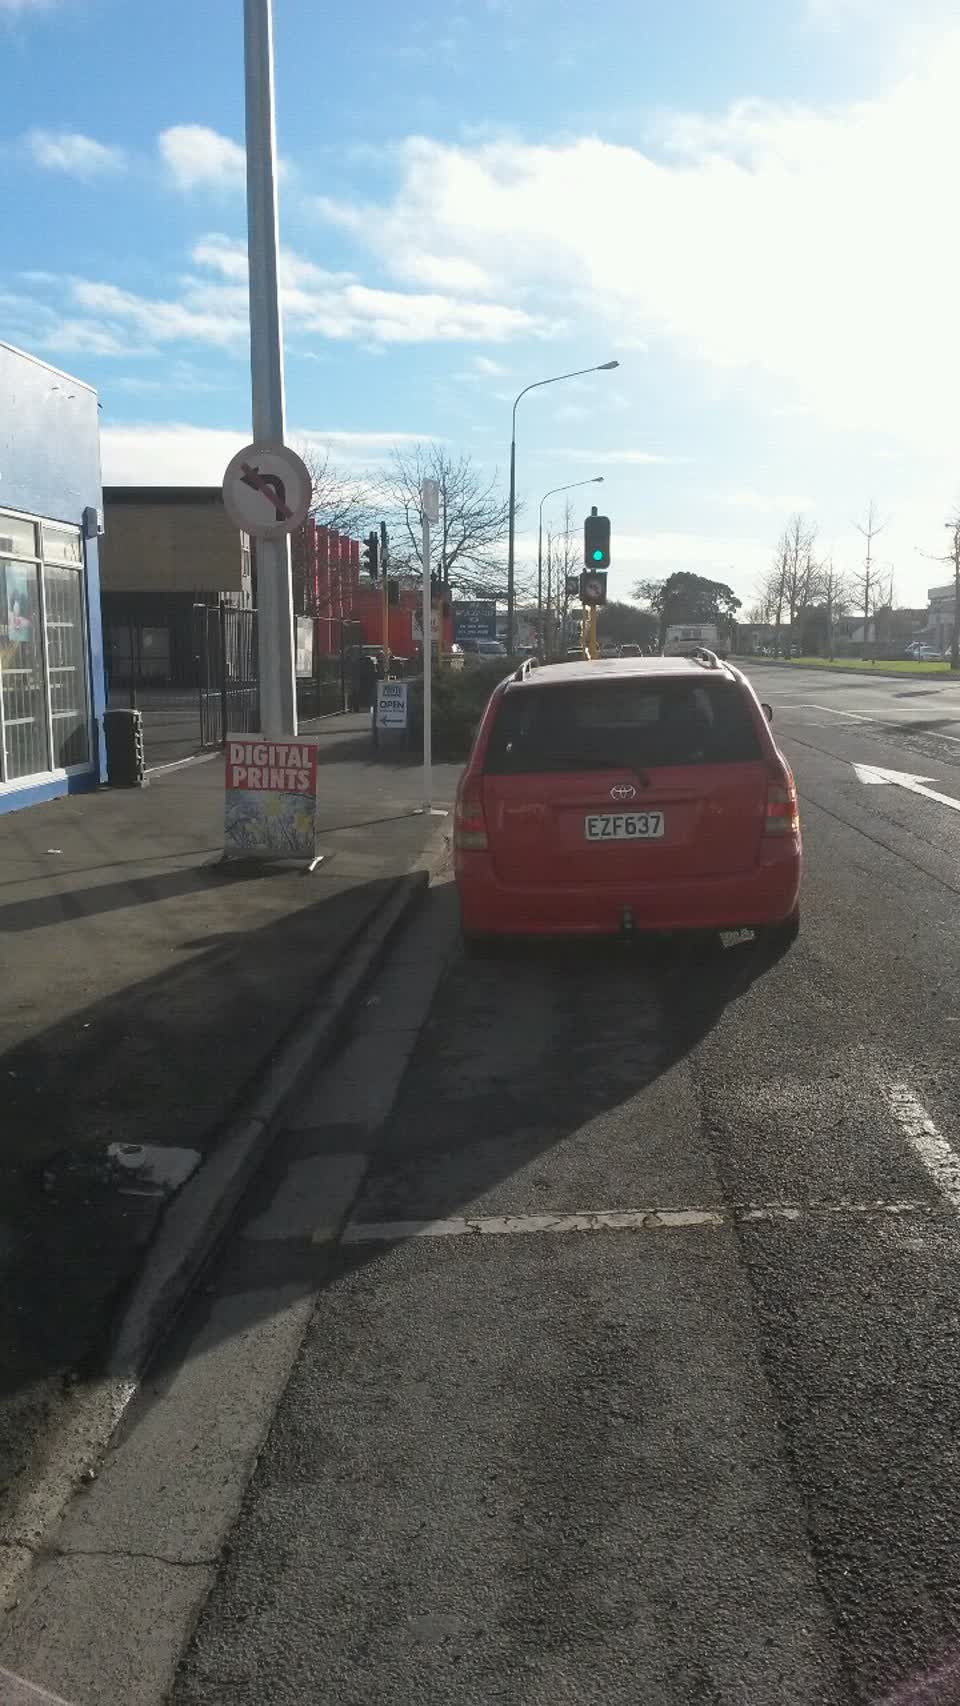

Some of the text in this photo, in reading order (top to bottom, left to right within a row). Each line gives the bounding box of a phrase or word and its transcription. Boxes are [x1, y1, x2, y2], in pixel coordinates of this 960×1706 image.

[379, 700, 405, 709] OPEN
[230, 743, 313, 769] DIGITAL
[232, 766, 310, 790] PRINTS
[587, 815, 661, 837] EZF637
